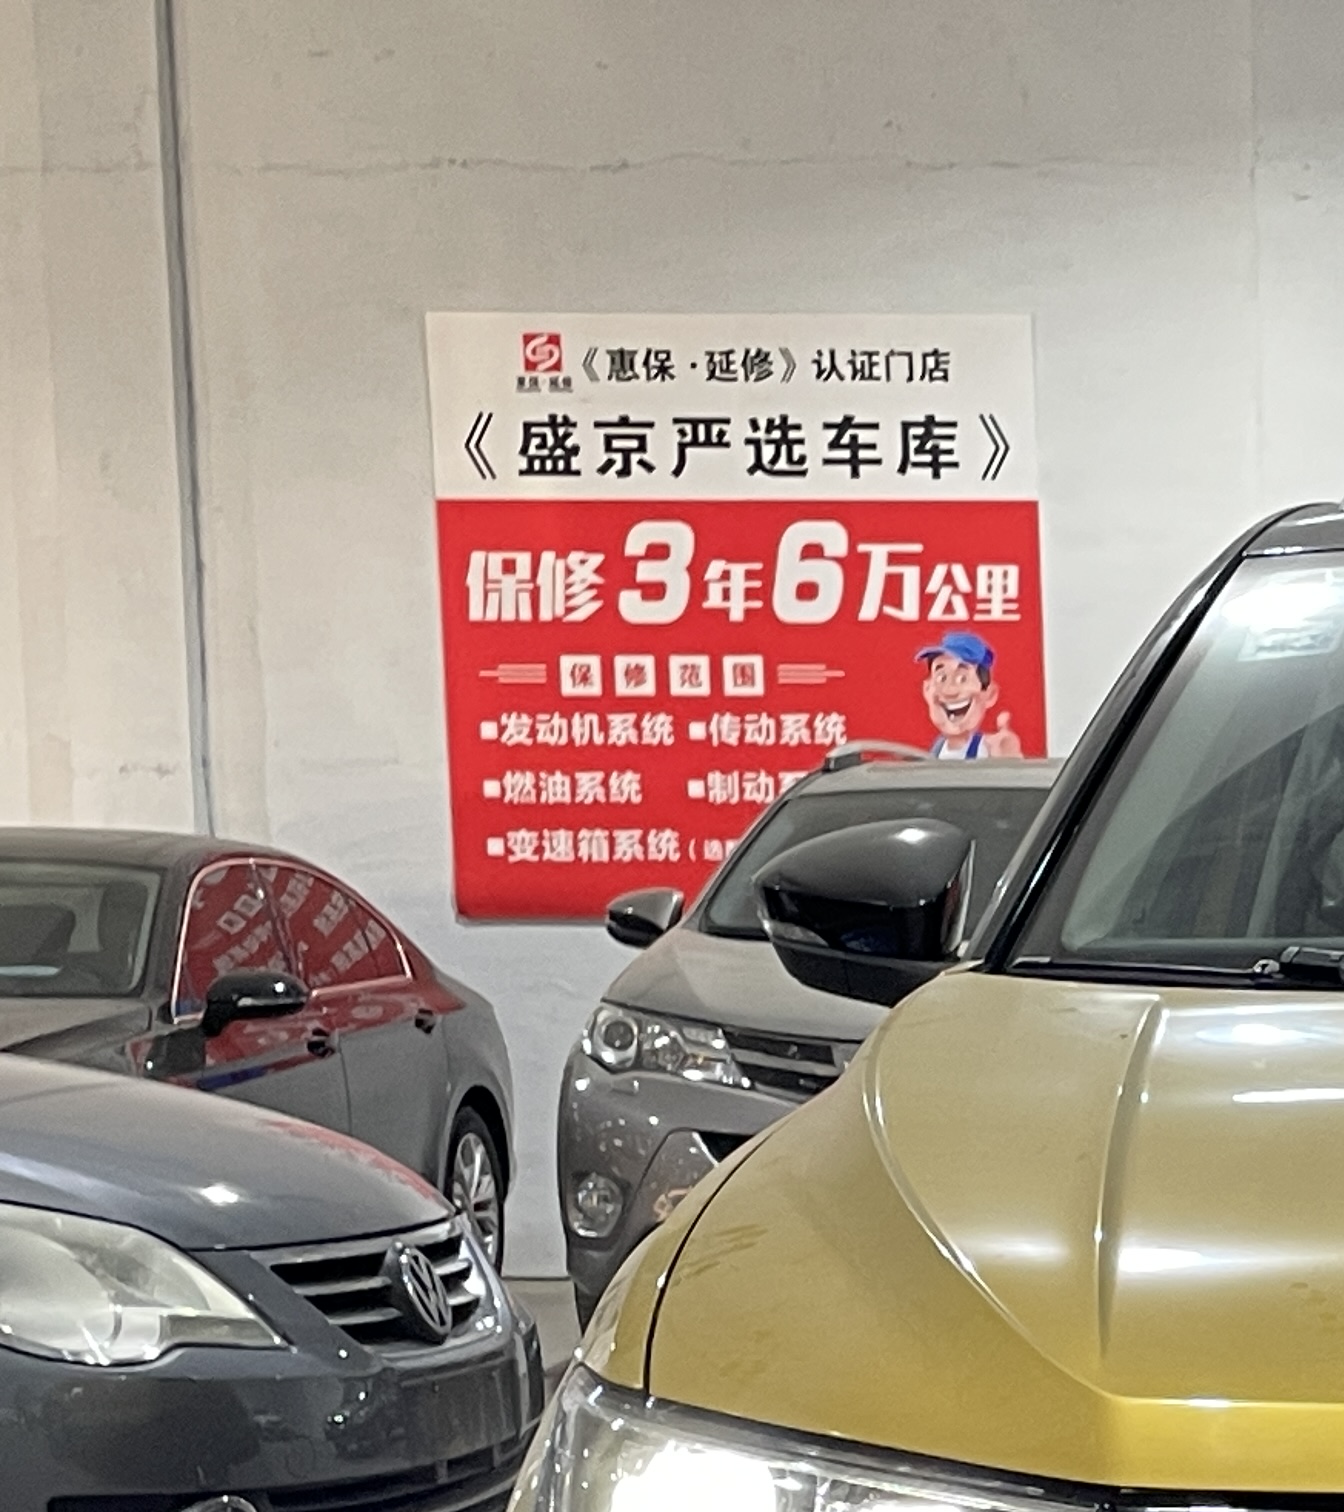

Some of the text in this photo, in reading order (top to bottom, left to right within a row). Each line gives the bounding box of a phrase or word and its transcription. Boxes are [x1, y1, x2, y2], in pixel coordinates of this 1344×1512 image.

[466, 519, 1022, 624] 保修3年6万公里
[500, 712, 675, 747] 发动机系统
[709, 712, 847, 747] 传动系统
[503, 771, 643, 804] 燃油系统
